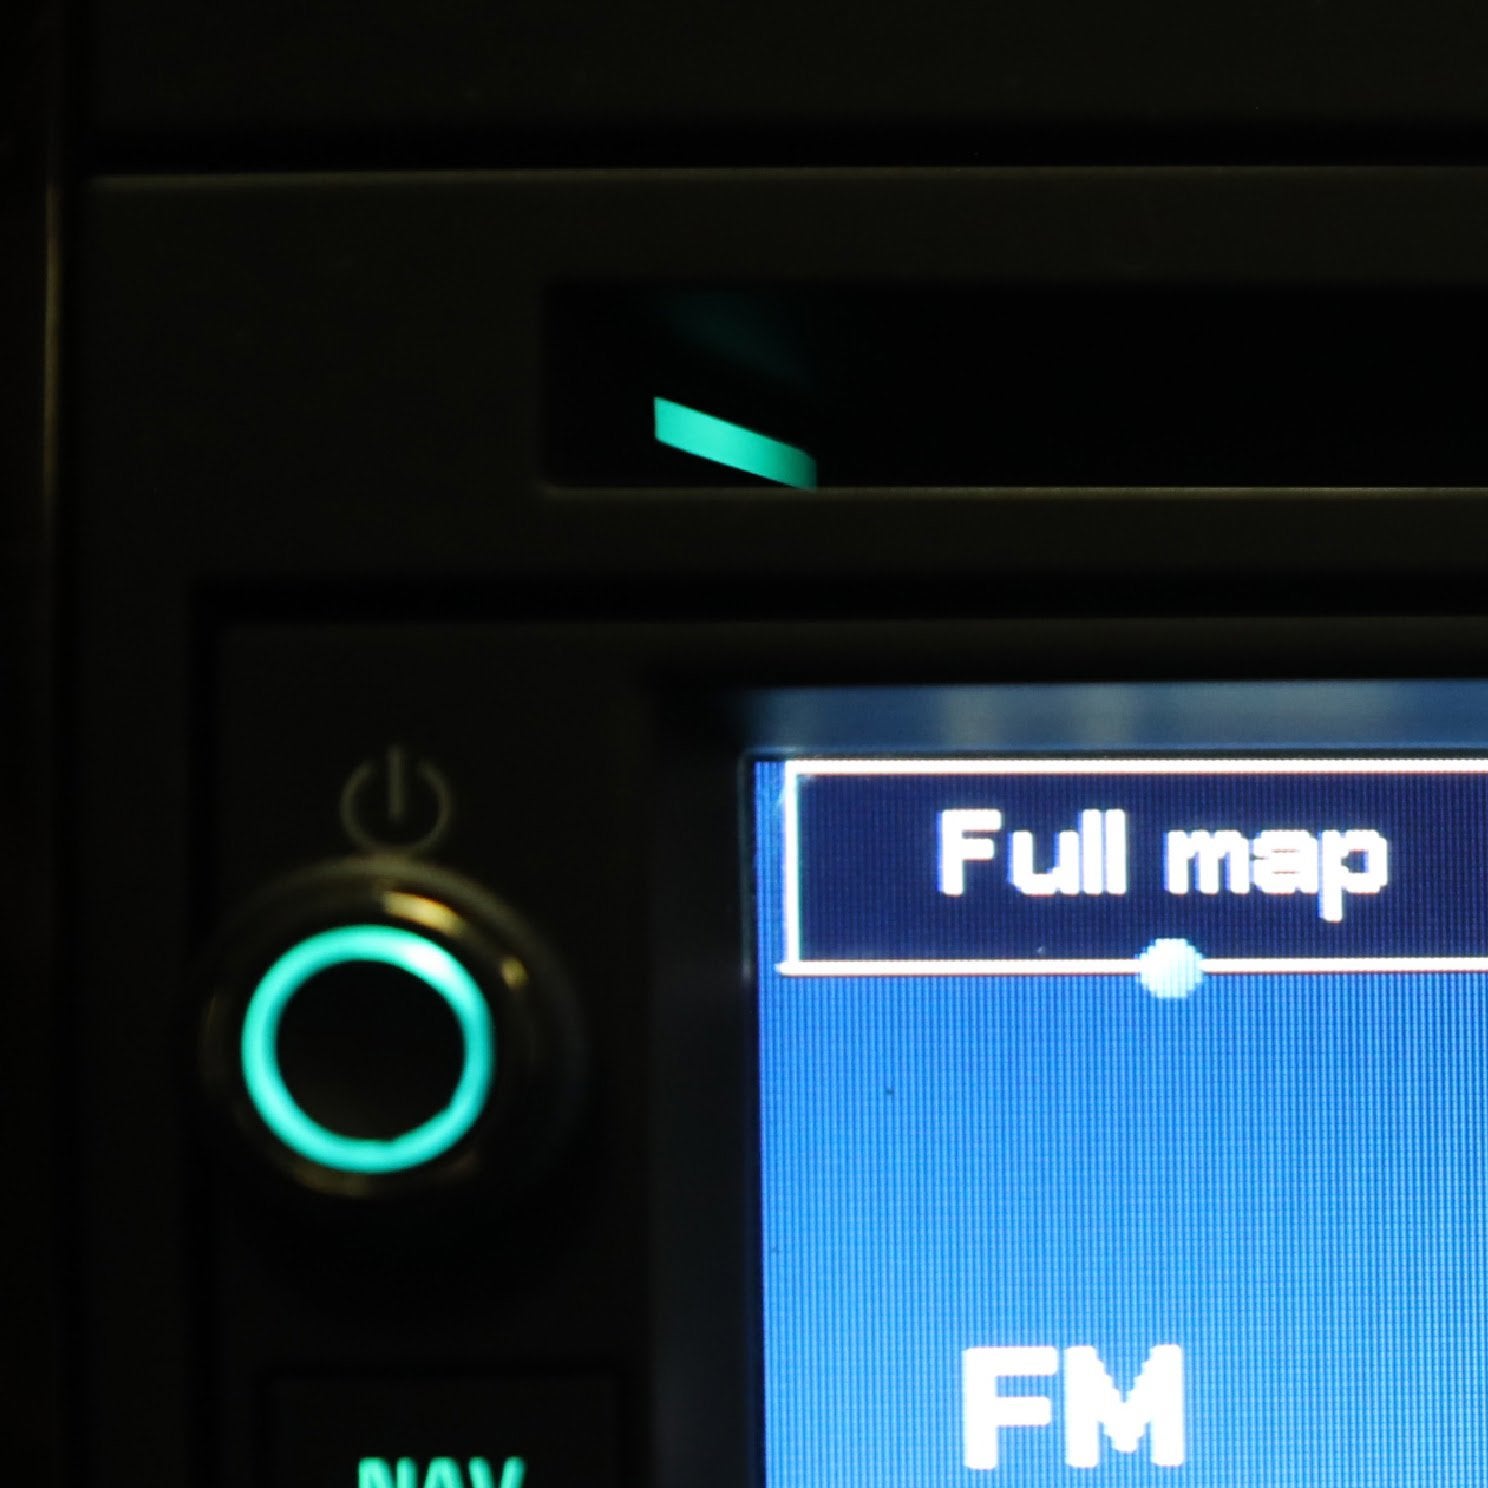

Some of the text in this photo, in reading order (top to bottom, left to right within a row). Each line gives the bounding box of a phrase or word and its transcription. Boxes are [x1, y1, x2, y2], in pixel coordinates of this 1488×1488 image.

[940, 808, 1387, 921] Full map
[964, 1344, 1184, 1469] FM
